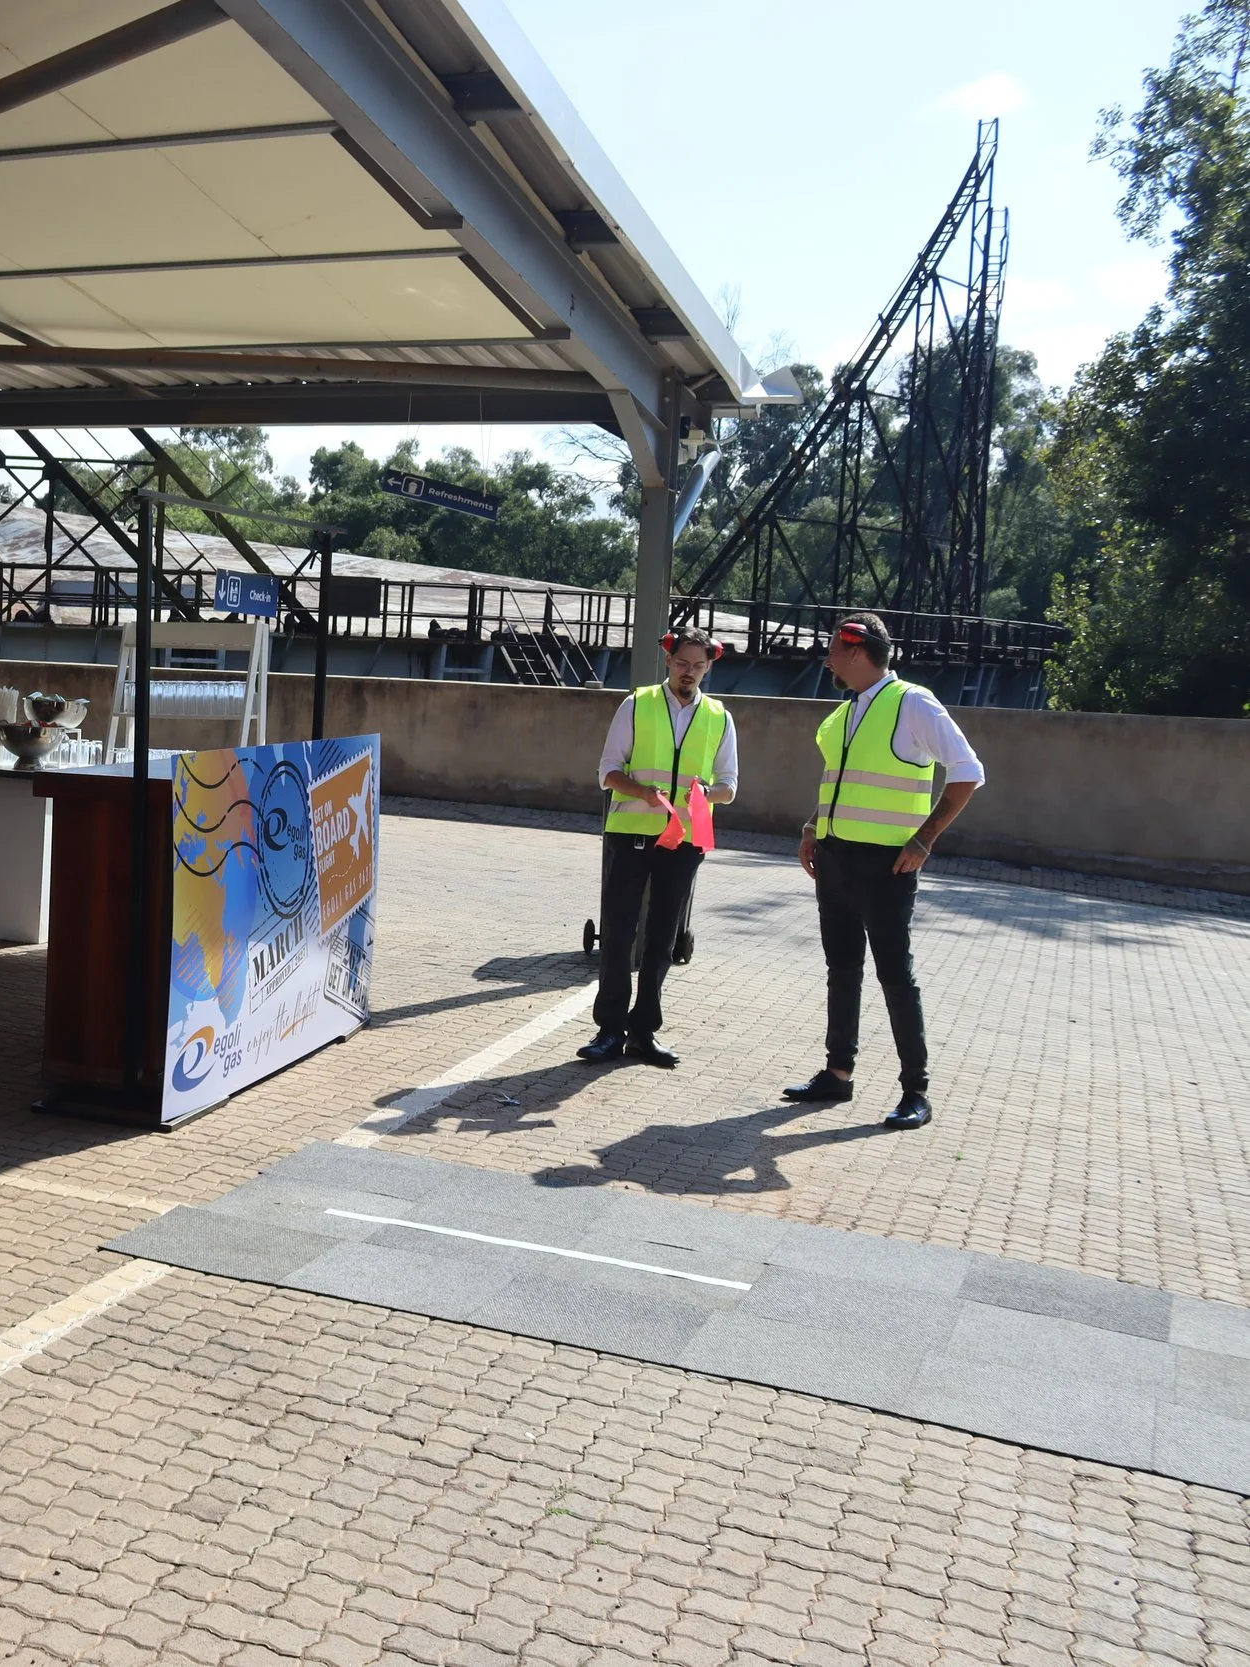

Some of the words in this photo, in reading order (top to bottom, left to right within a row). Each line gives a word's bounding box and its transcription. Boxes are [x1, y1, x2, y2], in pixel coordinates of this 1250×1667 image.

[428, 487, 494, 511] Refreshments
[250, 589, 271, 603] Check-in
[313, 804, 324, 824] GET
[324, 799, 333, 816] ON
[287, 824, 305, 843] egoli
[315, 807, 350, 857] BOARD
[294, 844, 306, 861] gas
[318, 850, 335, 876] FLIGHT
[252, 910, 303, 988] MARCH
[213, 1022, 243, 1058] egoli
[246, 1024, 274, 1064] enjoy
[222, 1048, 243, 1078] gas
